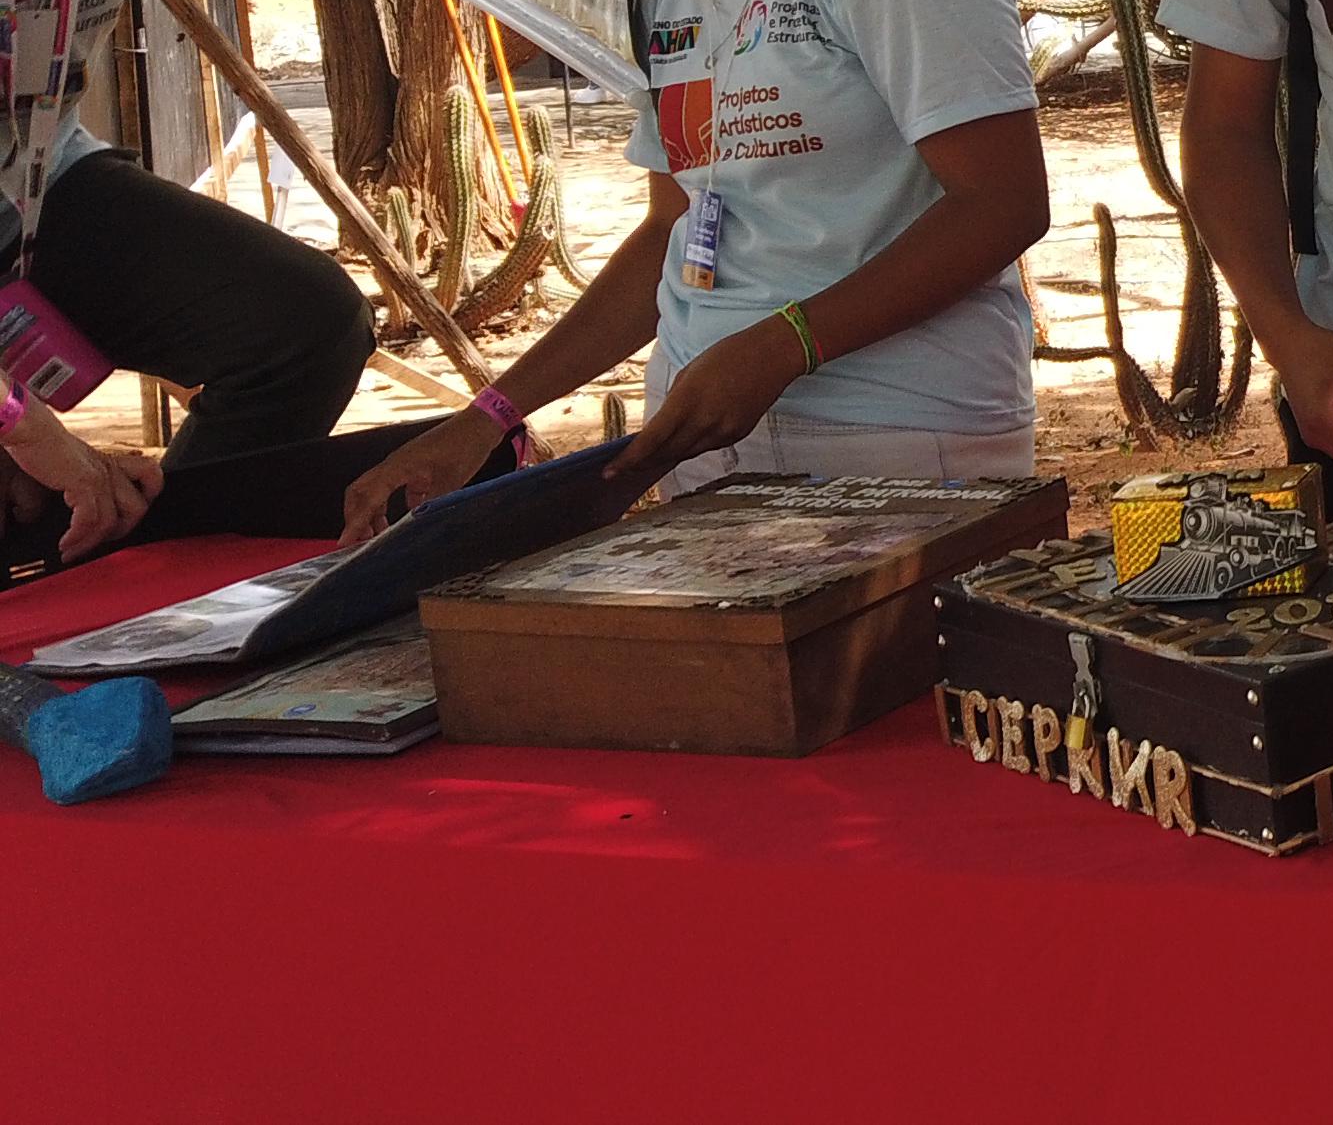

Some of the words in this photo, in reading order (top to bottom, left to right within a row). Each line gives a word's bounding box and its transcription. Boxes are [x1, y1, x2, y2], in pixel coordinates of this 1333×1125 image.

[769, 19, 776, 28] e
[650, 26, 700, 54] AHIA
[718, 85, 780, 111] Projetos
[719, 111, 803, 138] Artísticos
[722, 148, 732, 161] e
[735, 133, 823, 160] Culturais
[851, 487, 1011, 500] PATRIMONIAL
